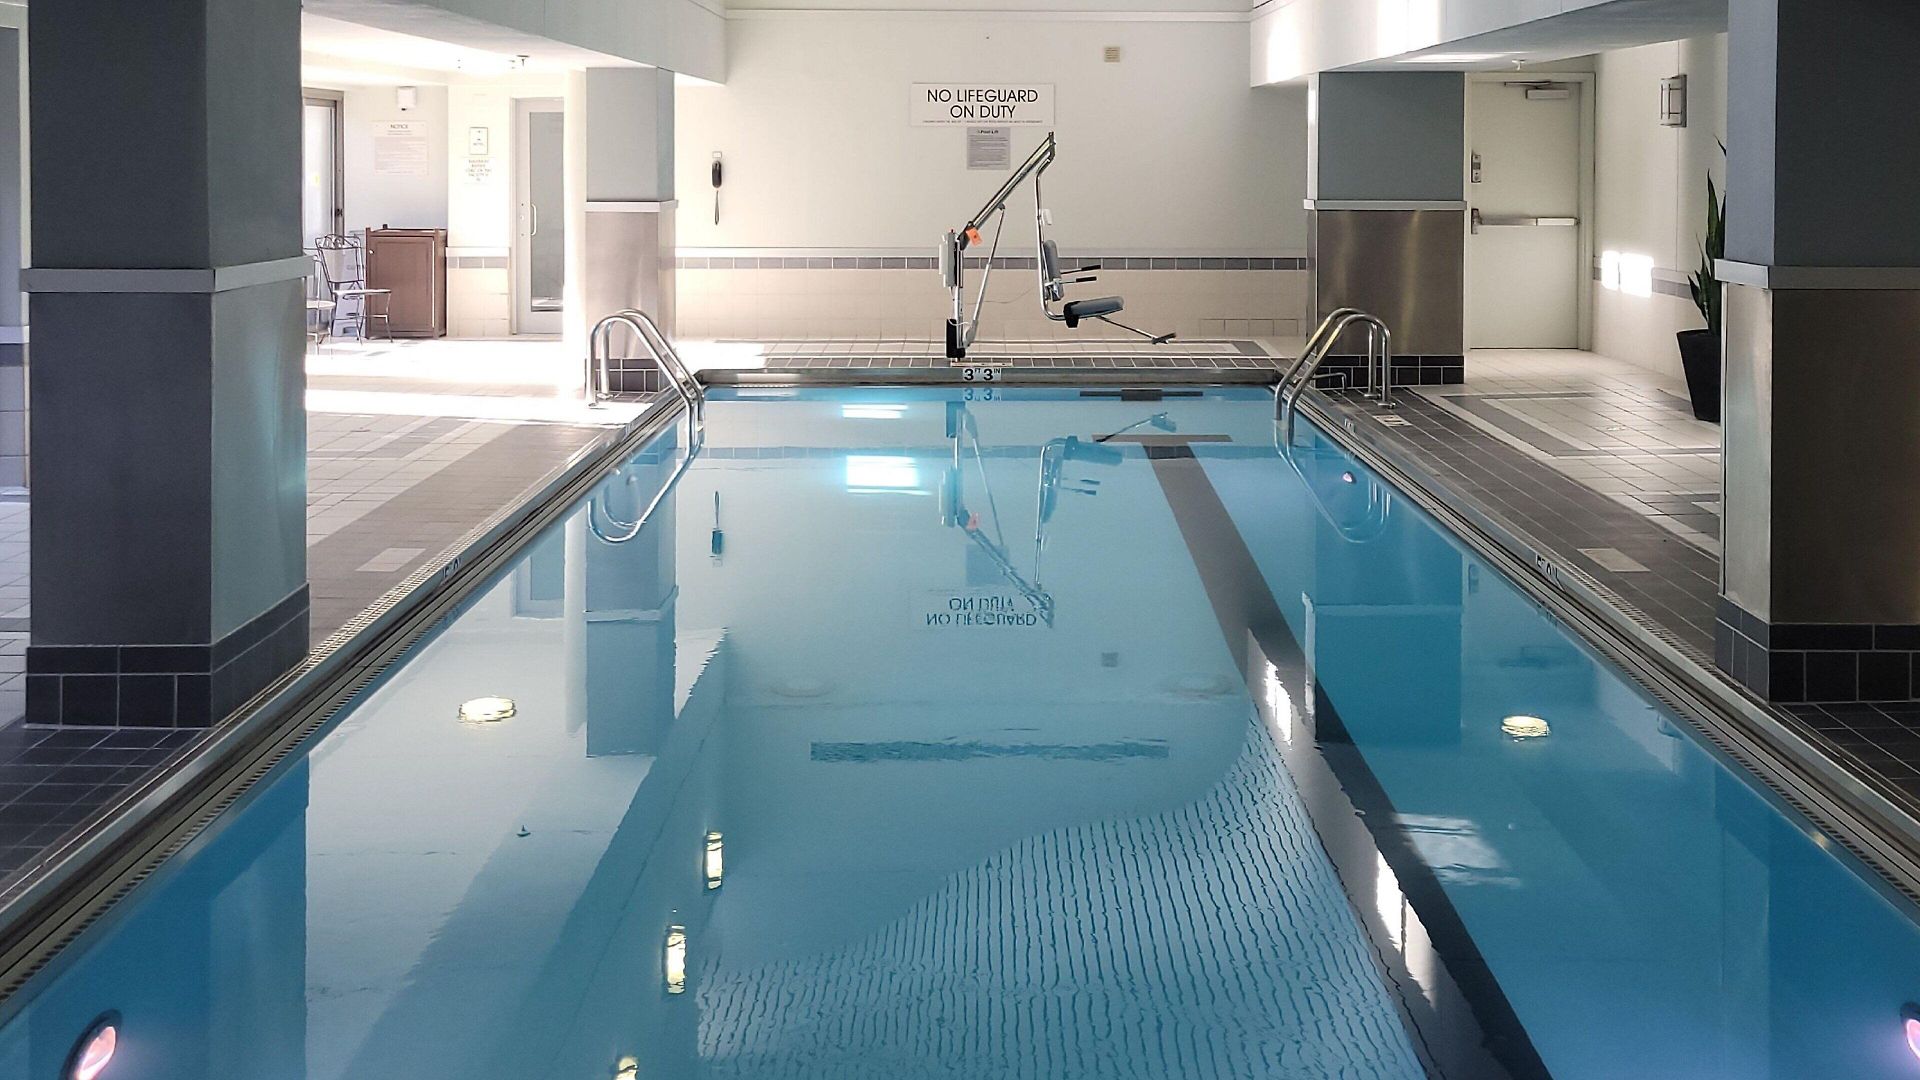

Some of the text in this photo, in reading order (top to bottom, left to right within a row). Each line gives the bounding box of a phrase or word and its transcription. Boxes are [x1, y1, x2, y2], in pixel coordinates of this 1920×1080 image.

[927, 89, 1039, 103] NO LIFEGUARD
[950, 105, 1016, 118] ON DUTY
[964, 368, 974, 380] 3
[983, 368, 993, 380] 3
